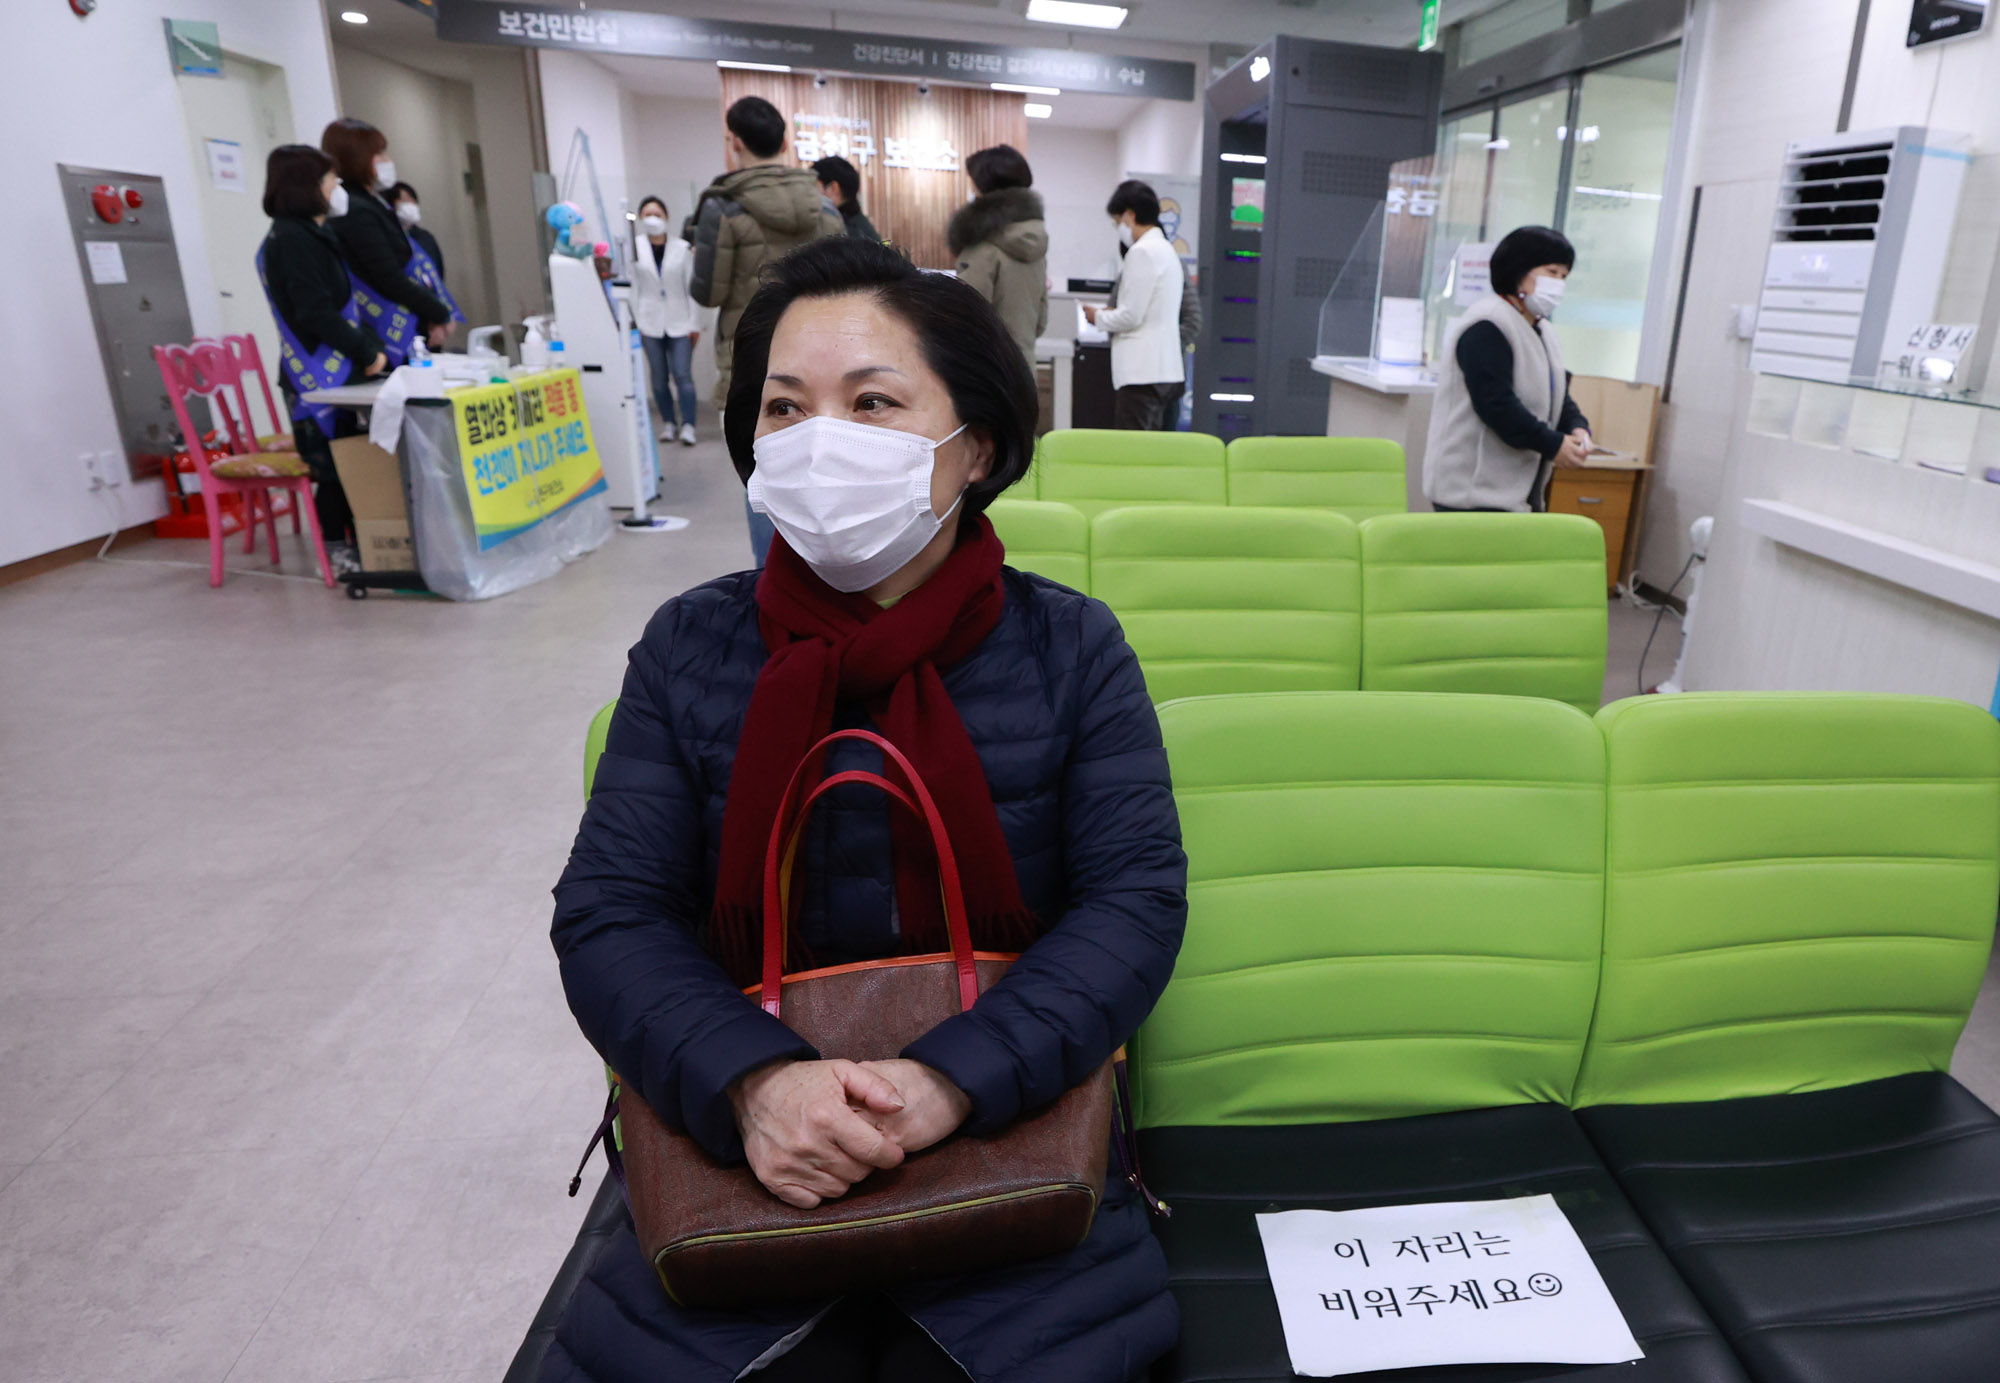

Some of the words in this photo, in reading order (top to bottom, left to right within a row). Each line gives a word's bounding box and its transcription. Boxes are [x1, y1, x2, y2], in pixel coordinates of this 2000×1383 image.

[497, 10, 619, 45] 보건민원실
[853, 43, 924, 66] 건강진단서
[947, 51, 1002, 74] 건강진단
[1117, 66, 1146, 86] 수납
[794, 131, 877, 165] 금천구
[883, 136, 960, 171] 보소
[465, 398, 507, 446] 열화상
[472, 445, 520, 496] 천천히
[554, 419, 589, 461] 주세요
[1334, 1238, 1371, 1267] 이
[1391, 1230, 1511, 1263] 자리는
[1319, 1277, 1532, 1320] 비워주세요
